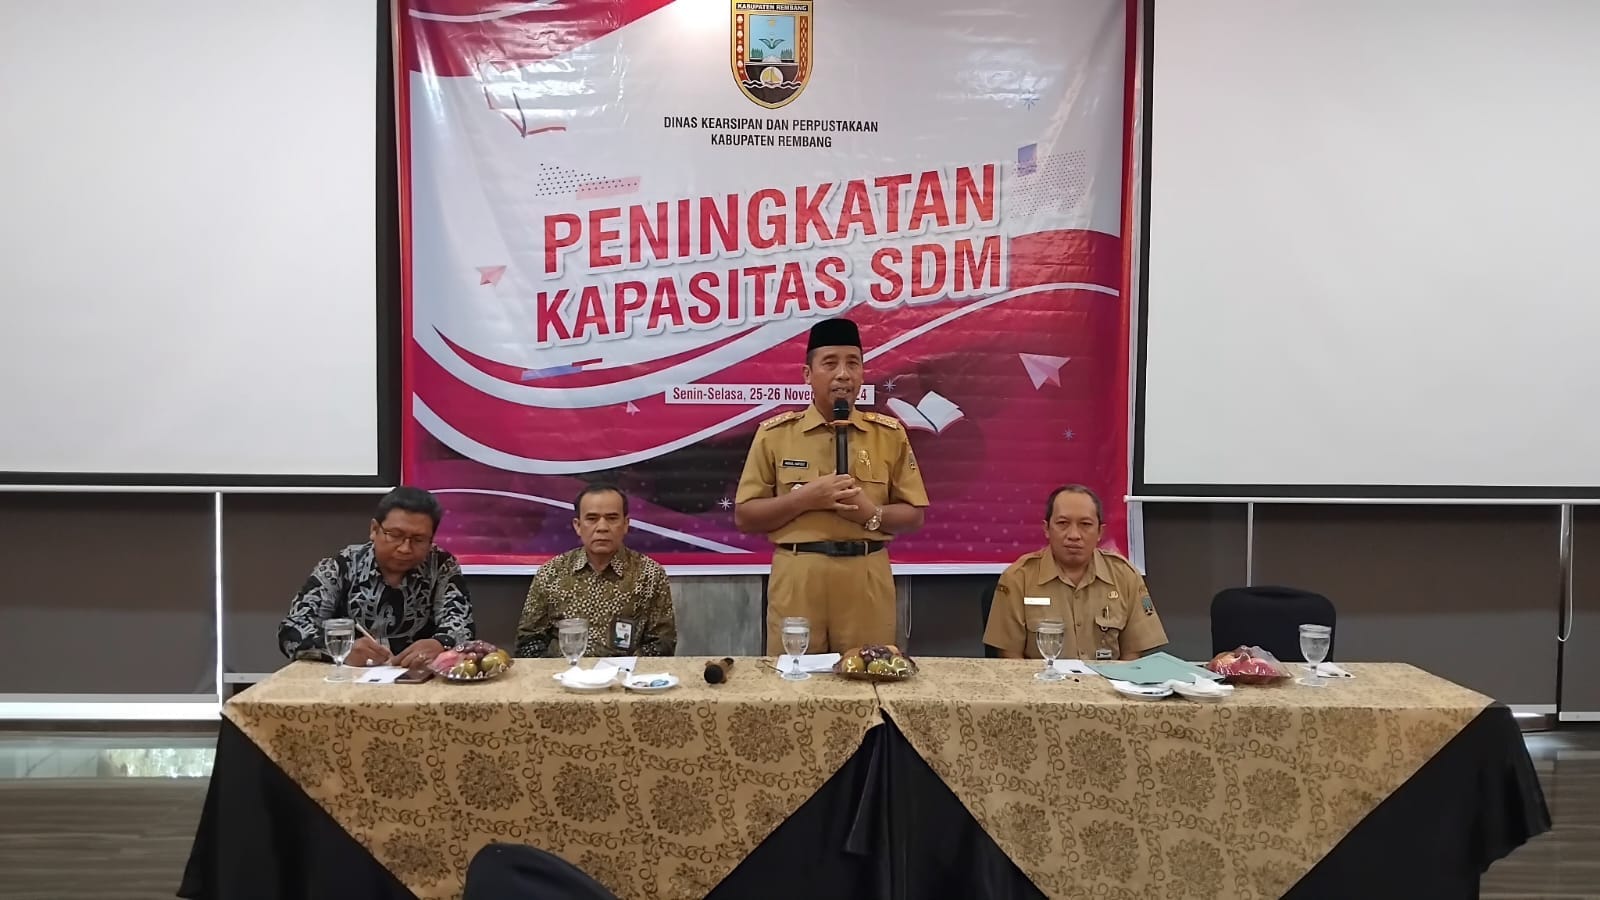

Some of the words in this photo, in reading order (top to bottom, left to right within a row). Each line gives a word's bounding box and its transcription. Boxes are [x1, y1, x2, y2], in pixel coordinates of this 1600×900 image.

[664, 116, 698, 128] DINAS
[701, 117, 763, 130] KEARSIPAN
[766, 119, 789, 131] DAN
[792, 119, 878, 132] PERPUSTAKAAN
[711, 133, 775, 146] KABUPATEN
[778, 135, 832, 148] REMBANG
[544, 163, 996, 274] PENINGKATAN
[536, 256, 848, 343] KAPASITAS
[869, 235, 1002, 303] SDM
[673, 387, 746, 401] Senin-Selasa,
[750, 387, 781, 400] 25-26
